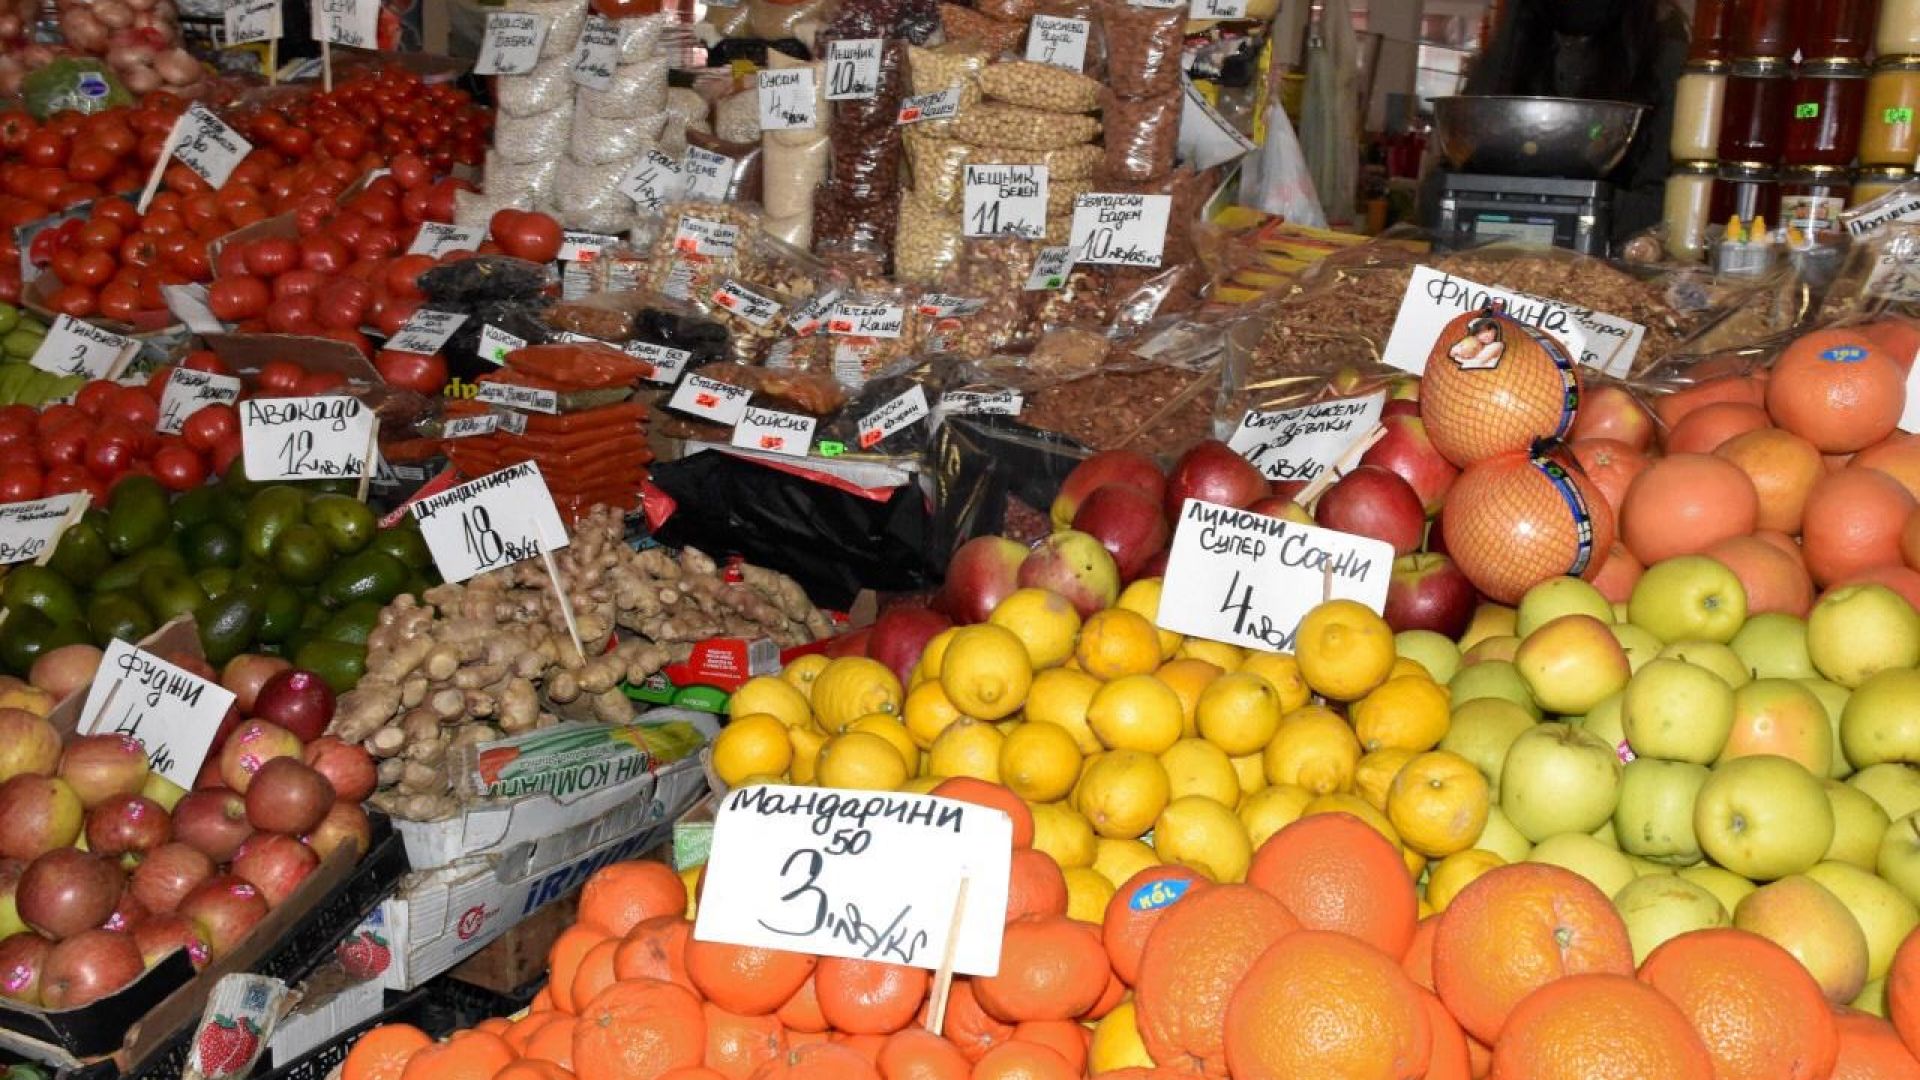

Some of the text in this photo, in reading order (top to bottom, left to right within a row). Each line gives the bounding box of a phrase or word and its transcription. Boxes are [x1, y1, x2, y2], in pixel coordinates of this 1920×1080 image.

[967, 166, 1034, 186] Лешник
[249, 398, 361, 432] Авокадо
[1188, 501, 1287, 539] Лимони
[1199, 527, 1267, 563] Супер
[117, 647, 206, 709] Фуджи
[729, 785, 965, 836] Мандарини
